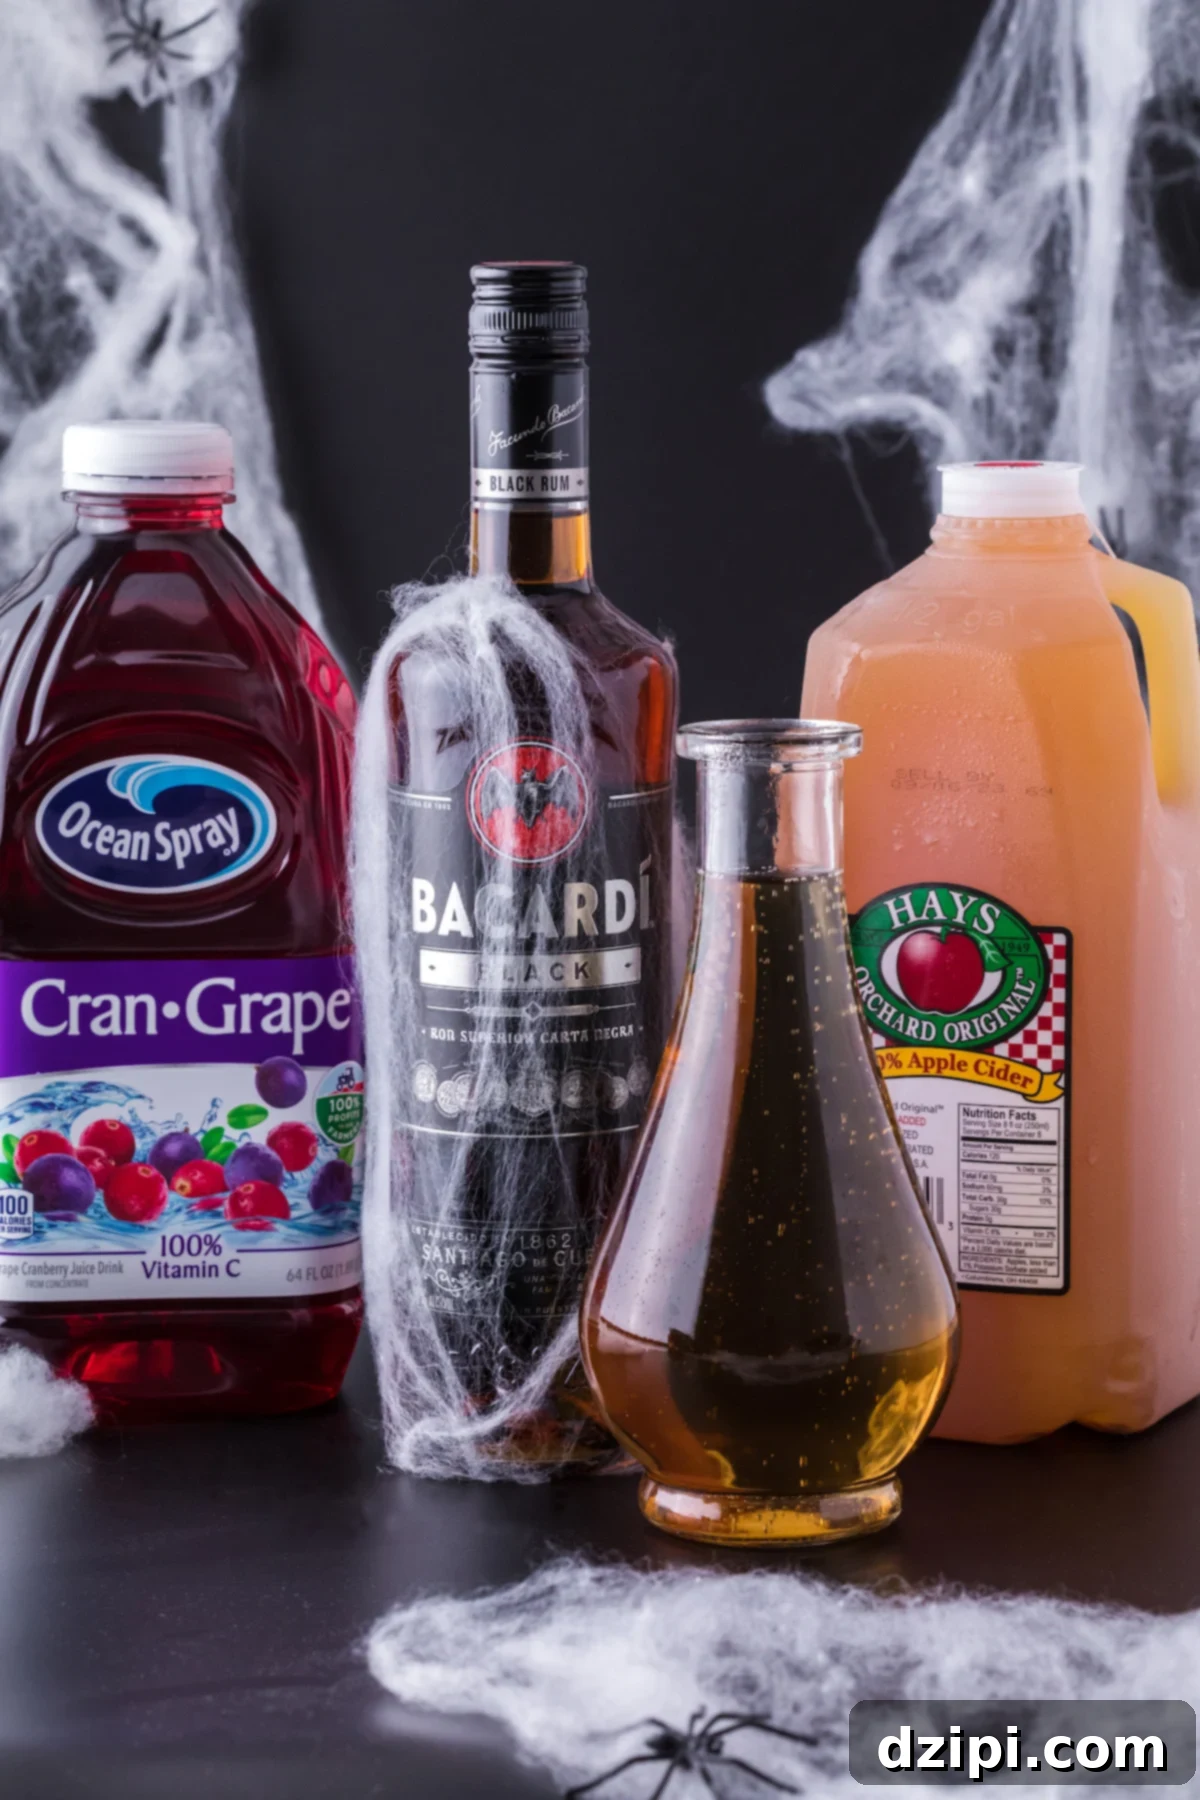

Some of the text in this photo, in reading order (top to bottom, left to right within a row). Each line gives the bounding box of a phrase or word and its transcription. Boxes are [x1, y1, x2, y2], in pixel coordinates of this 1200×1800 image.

[489, 474, 570, 492] BLACK RUM
[58, 801, 240, 870] Ocean Spray
[412, 853, 654, 939] BACARDÍ
[883, 890, 1000, 935] HAYS
[855, 966, 936, 1042] ORCHARD
[540, 1028, 589, 1044] CARTA
[907, 1052, 968, 1075] Apple
[972, 1058, 1034, 1090] Cider
[962, 1107, 1037, 1121] Nutrition Facts
[962, 1119, 986, 1128] Serving
[962, 1127, 989, 1136] Servings
[1004, 1129, 1036, 1137] Container
[0, 1195, 28, 1215] 100
[0, 1216, 32, 1225] ALORIES
[160, 1234, 222, 1257] 100%
[520, 1232, 571, 1250] 1862
[422, 1244, 527, 1268] SANTIAGO
[0, 1260, 124, 1279] rape Cranberry Juice Drink
[141, 1259, 241, 1279] Vitamin C
[286, 1268, 302, 1283] 64
[306, 1266, 319, 1281] FL
